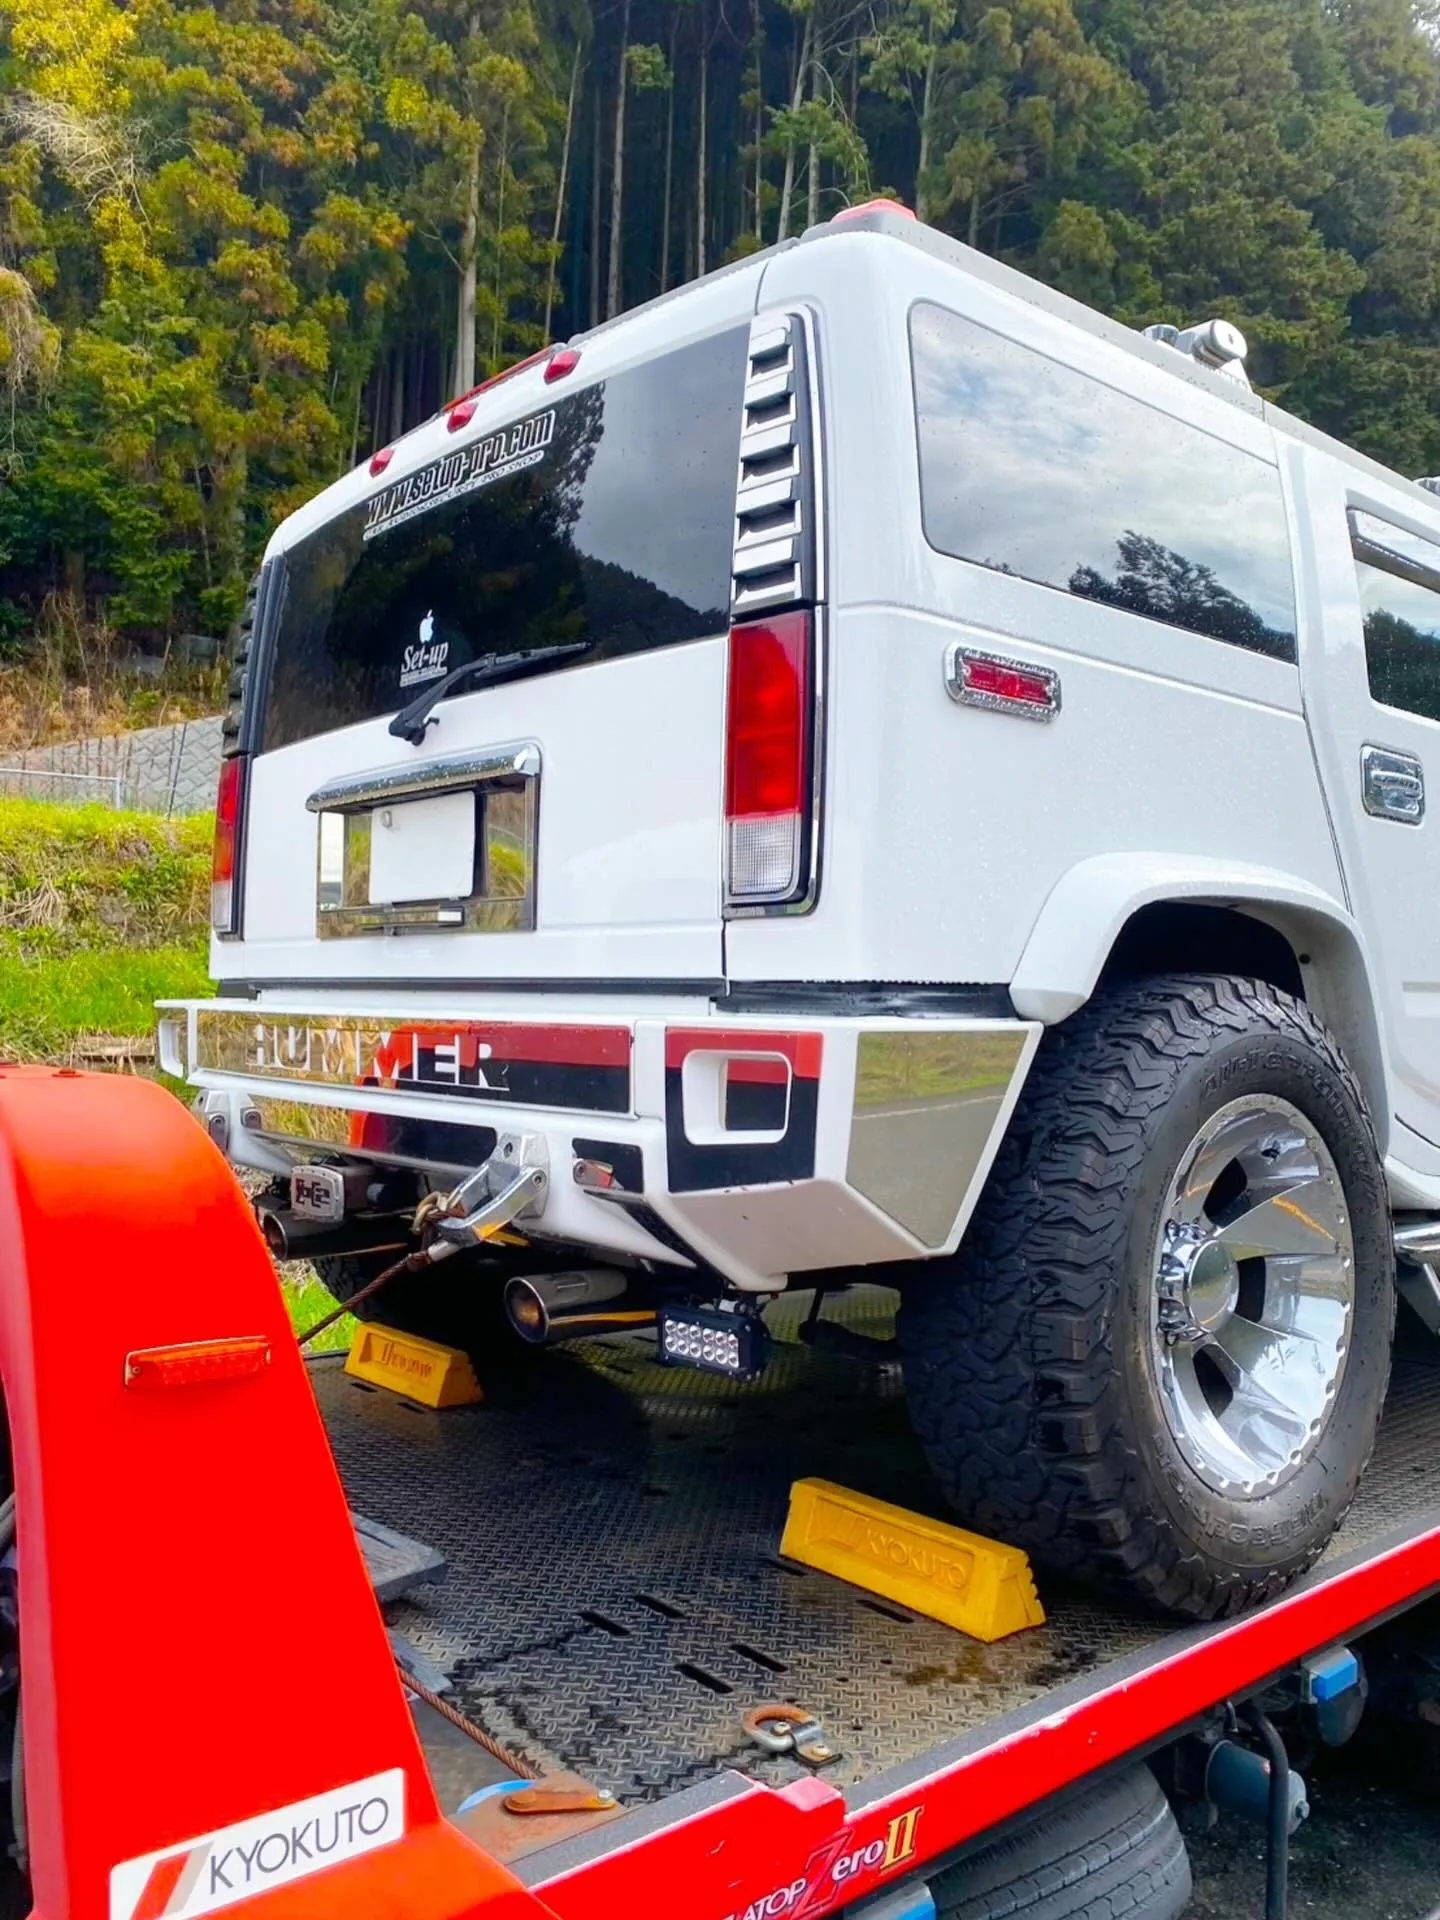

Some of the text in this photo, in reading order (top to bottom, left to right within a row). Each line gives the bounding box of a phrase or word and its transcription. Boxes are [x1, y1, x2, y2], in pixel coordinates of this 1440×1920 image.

[401, 642, 449, 674] Set-up
[245, 1023, 510, 1092] HUMMER
[866, 1527, 966, 1590] KYOKUTO
[209, 1796, 390, 1895] KYOKUTO
[722, 1877, 807, 1920] ATOP
